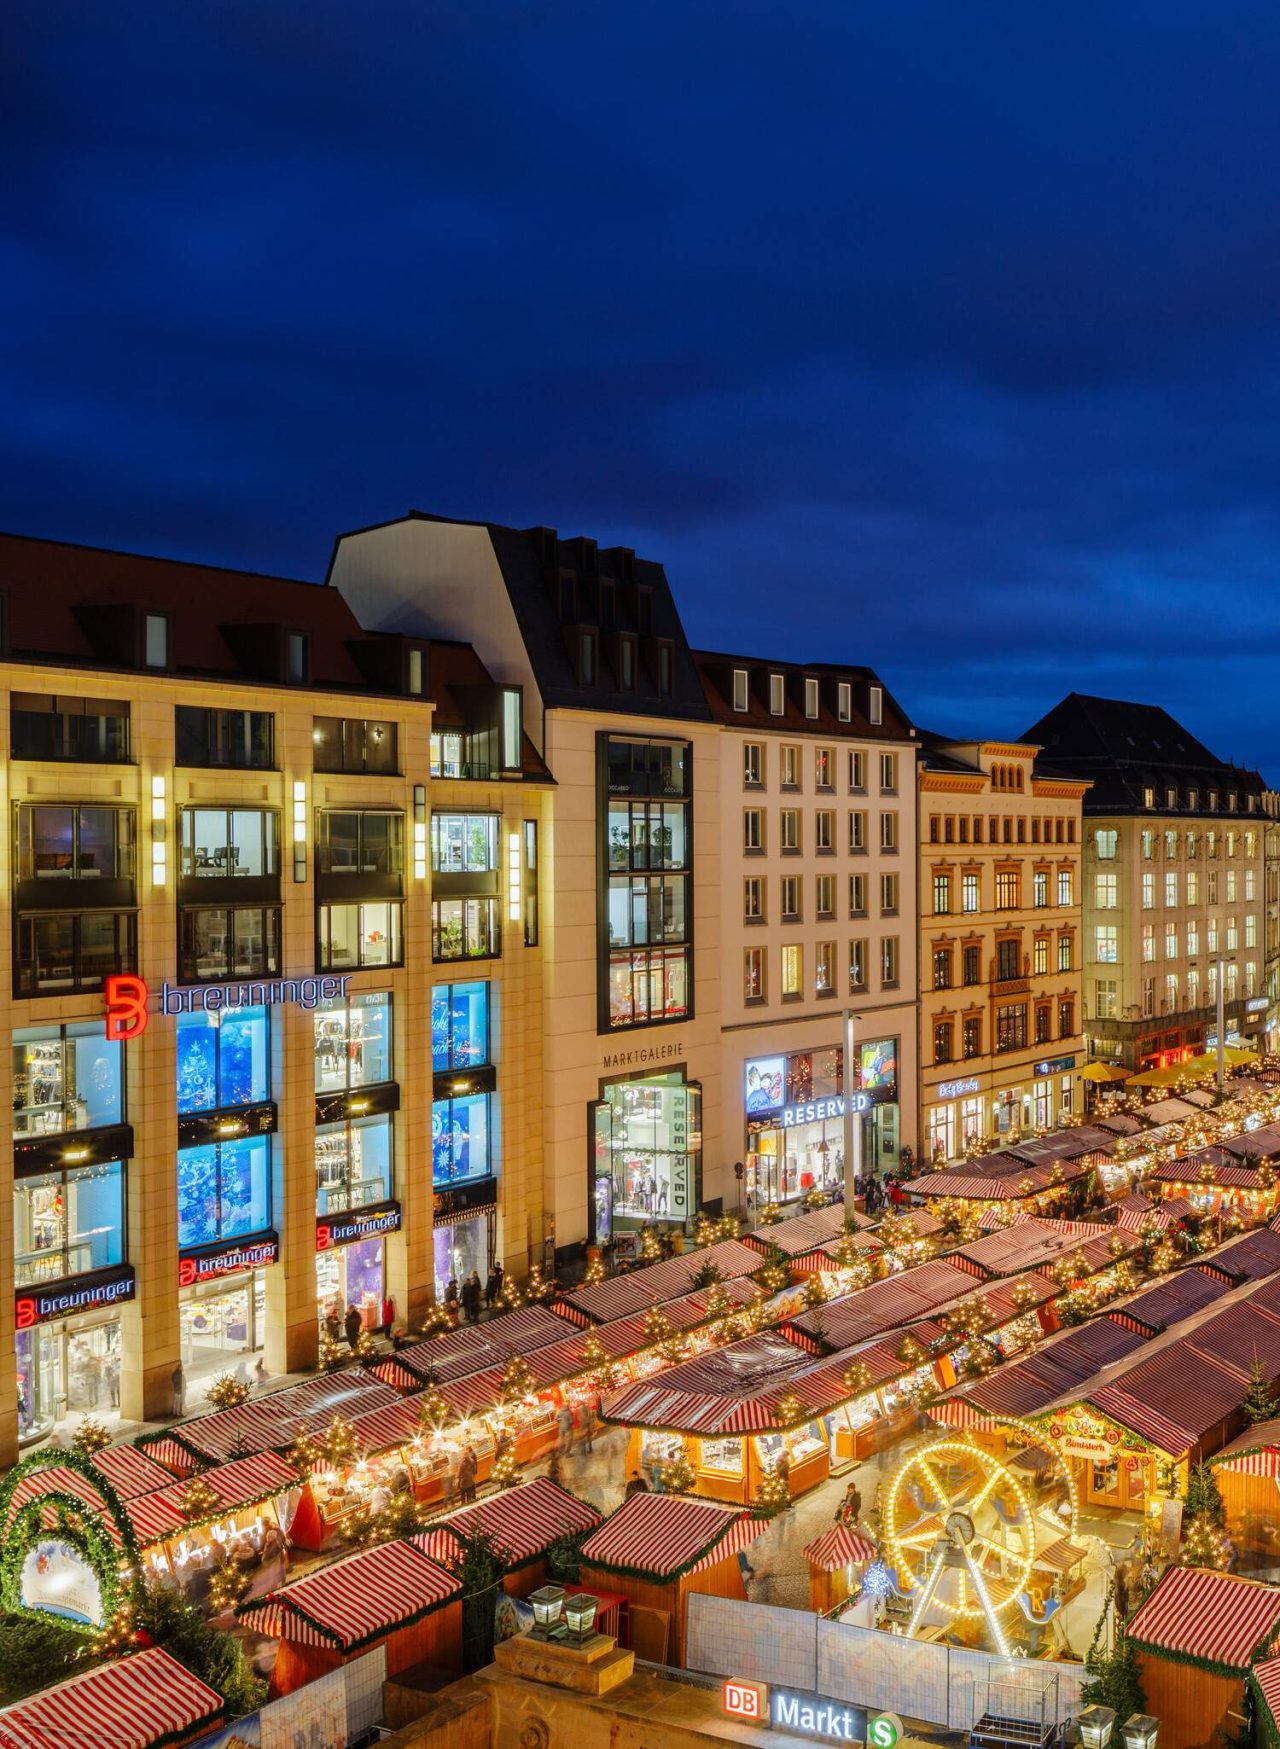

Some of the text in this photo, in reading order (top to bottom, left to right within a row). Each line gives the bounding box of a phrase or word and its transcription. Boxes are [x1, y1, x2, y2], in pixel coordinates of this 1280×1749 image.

[162, 975, 352, 1016] breuninger
[603, 1043, 684, 1069] MARKTGALERIE
[673, 1096, 685, 1206] RESERVED
[333, 1213, 400, 1240] breuninger
[199, 1243, 279, 1272] breuninger
[40, 1278, 134, 1315] breuninger
[728, 1688, 893, 1747] DB Markt S
